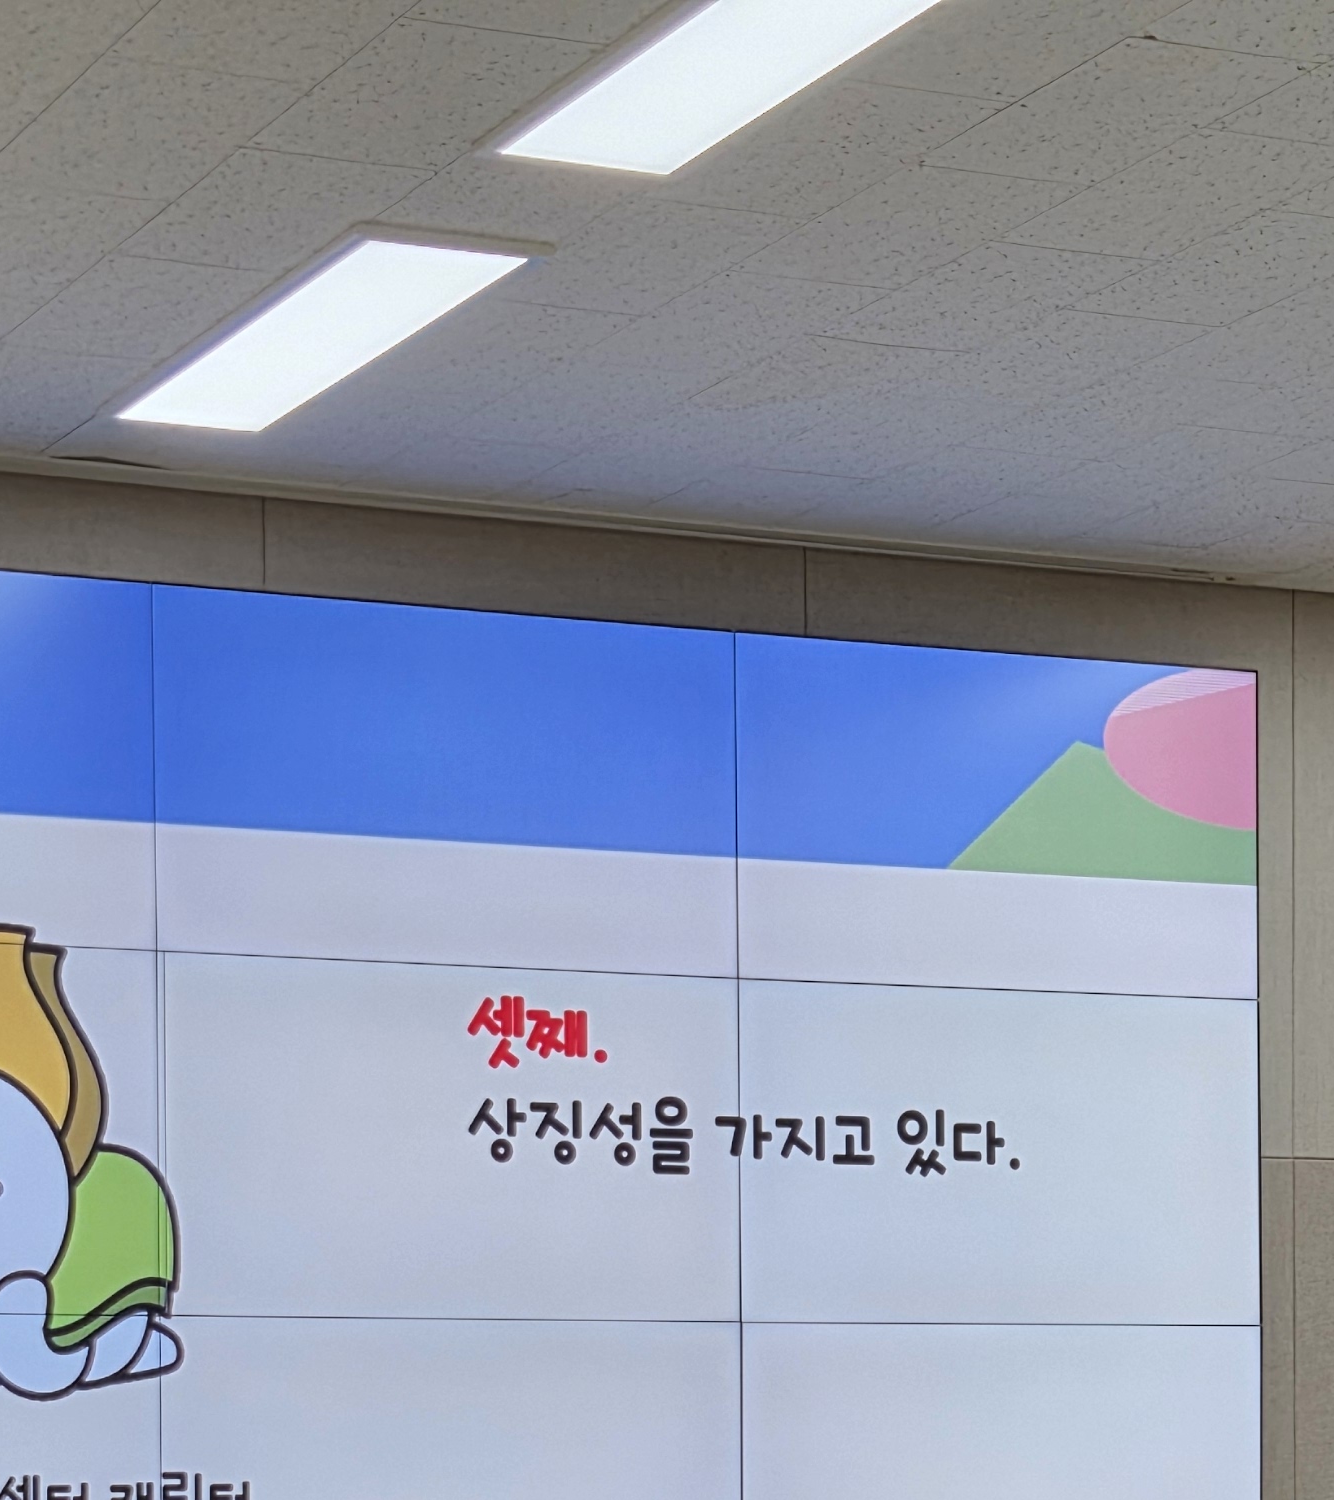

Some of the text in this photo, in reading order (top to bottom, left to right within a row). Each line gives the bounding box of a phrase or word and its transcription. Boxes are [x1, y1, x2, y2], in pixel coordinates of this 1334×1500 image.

[467, 995, 608, 1068] 셋째.
[468, 1096, 1021, 1177] 상징성을 가지고 있다.
